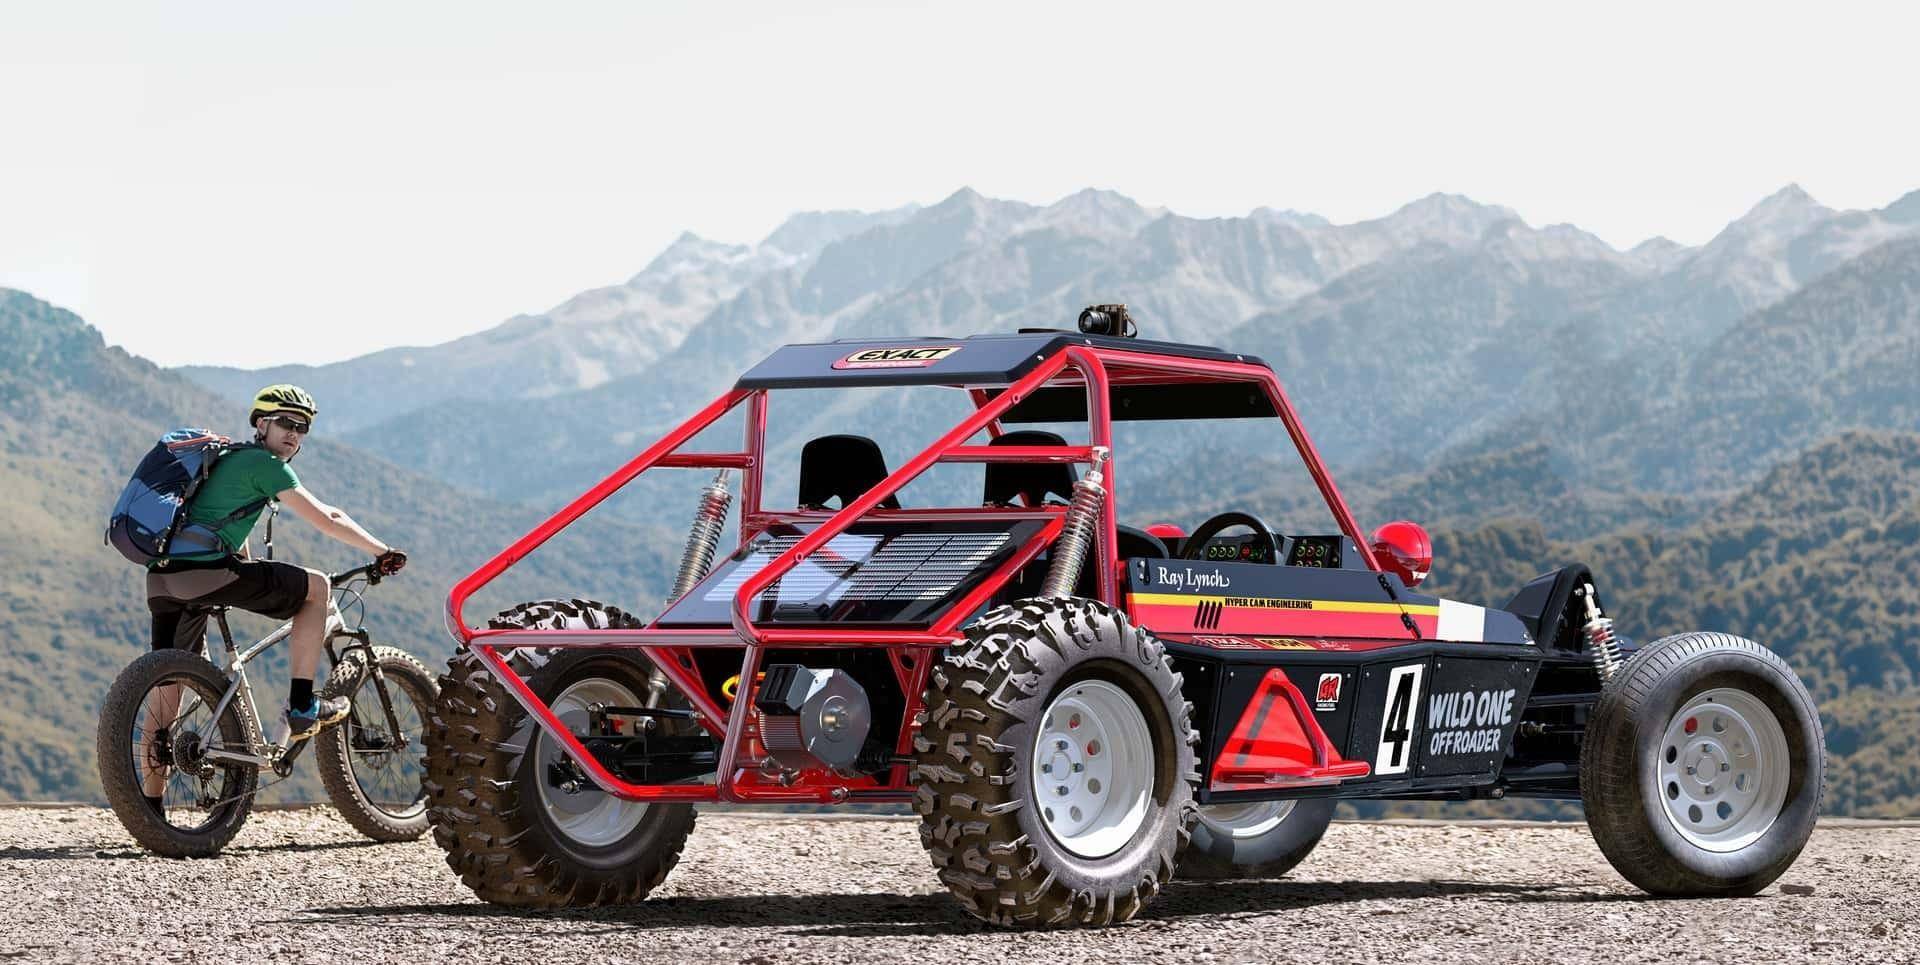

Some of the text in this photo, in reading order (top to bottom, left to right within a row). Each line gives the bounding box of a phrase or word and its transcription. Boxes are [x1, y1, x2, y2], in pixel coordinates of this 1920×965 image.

[857, 348, 951, 360] EXACT
[1157, 566, 1230, 592] Ray Lynch
[1225, 597, 1313, 610] HYPER CAM ENGINEERING
[1382, 672, 1415, 767] 4
[1428, 688, 1516, 729] WILD ONE
